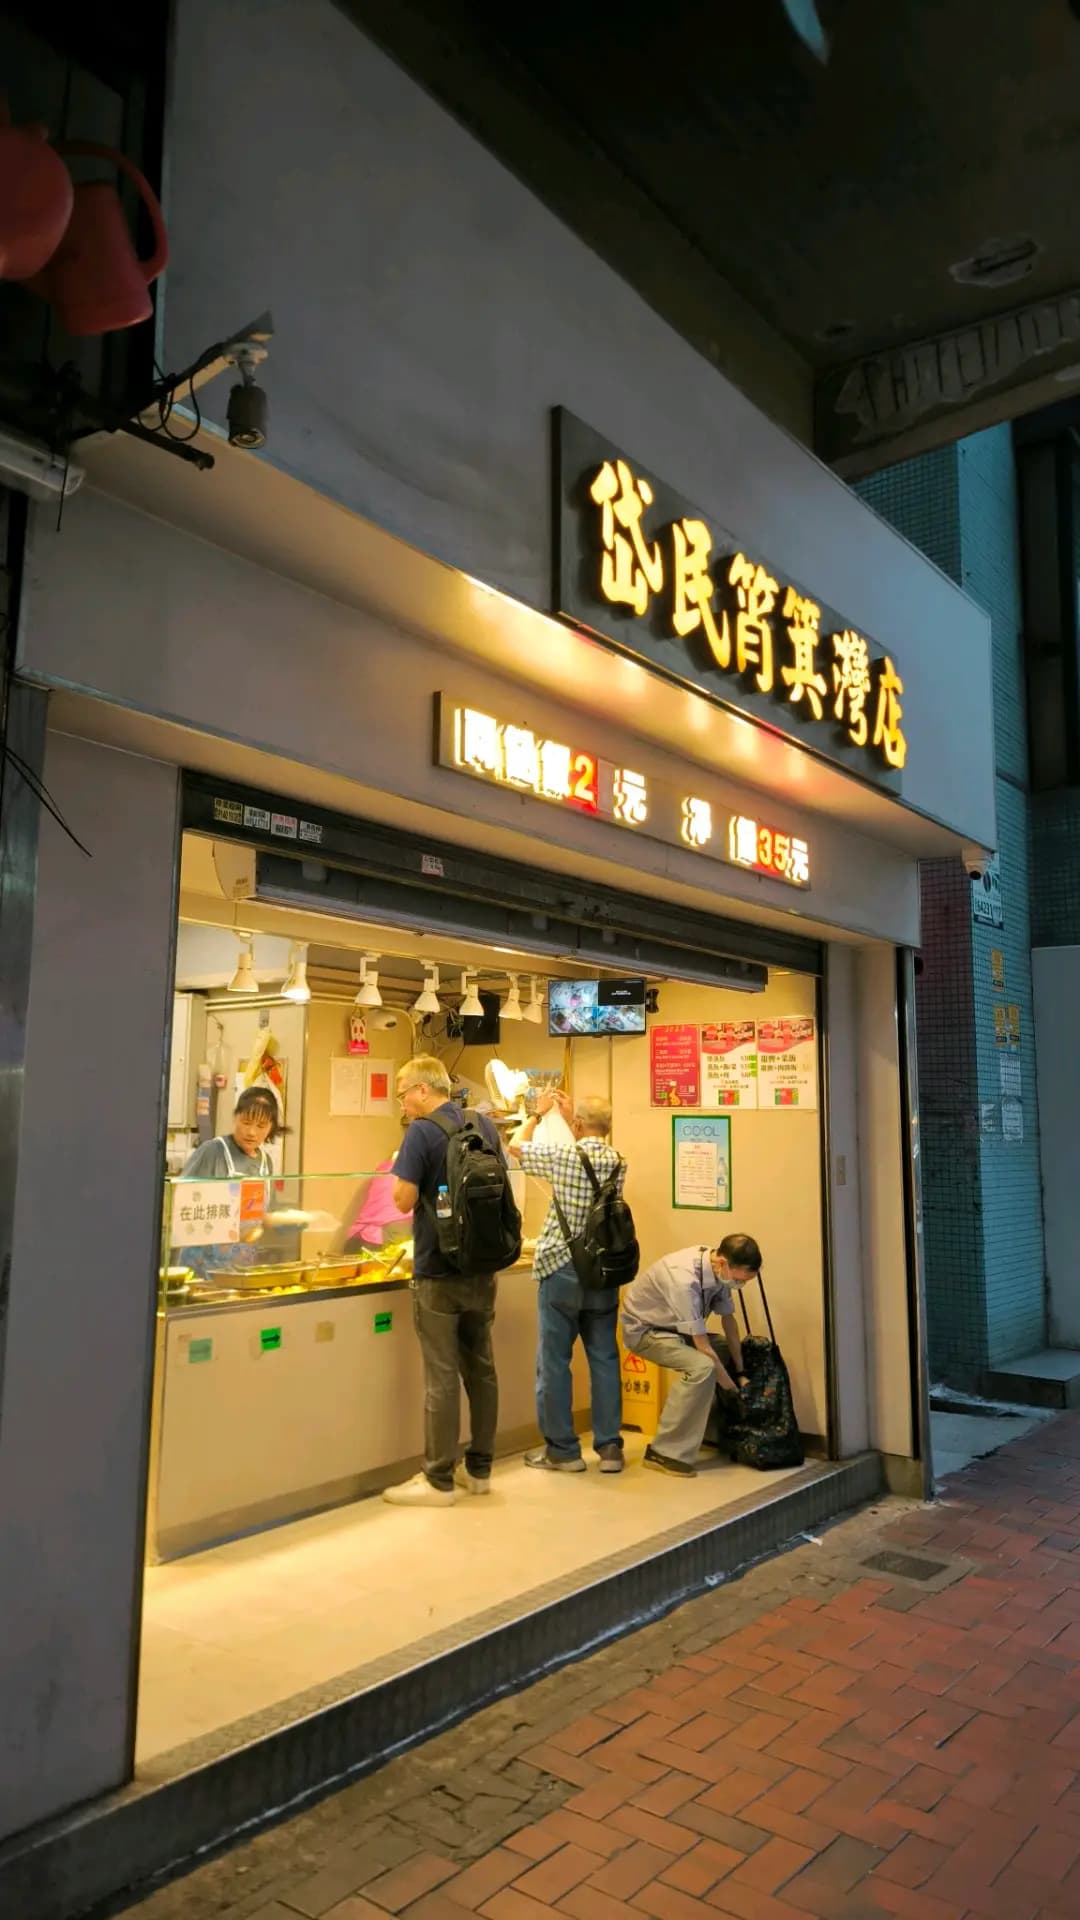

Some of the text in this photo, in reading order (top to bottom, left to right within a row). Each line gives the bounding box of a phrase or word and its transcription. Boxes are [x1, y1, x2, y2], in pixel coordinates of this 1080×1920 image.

[590, 459, 907, 769] 岱民筲箕灣店
[180, 1204, 231, 1221] 在此排隊
